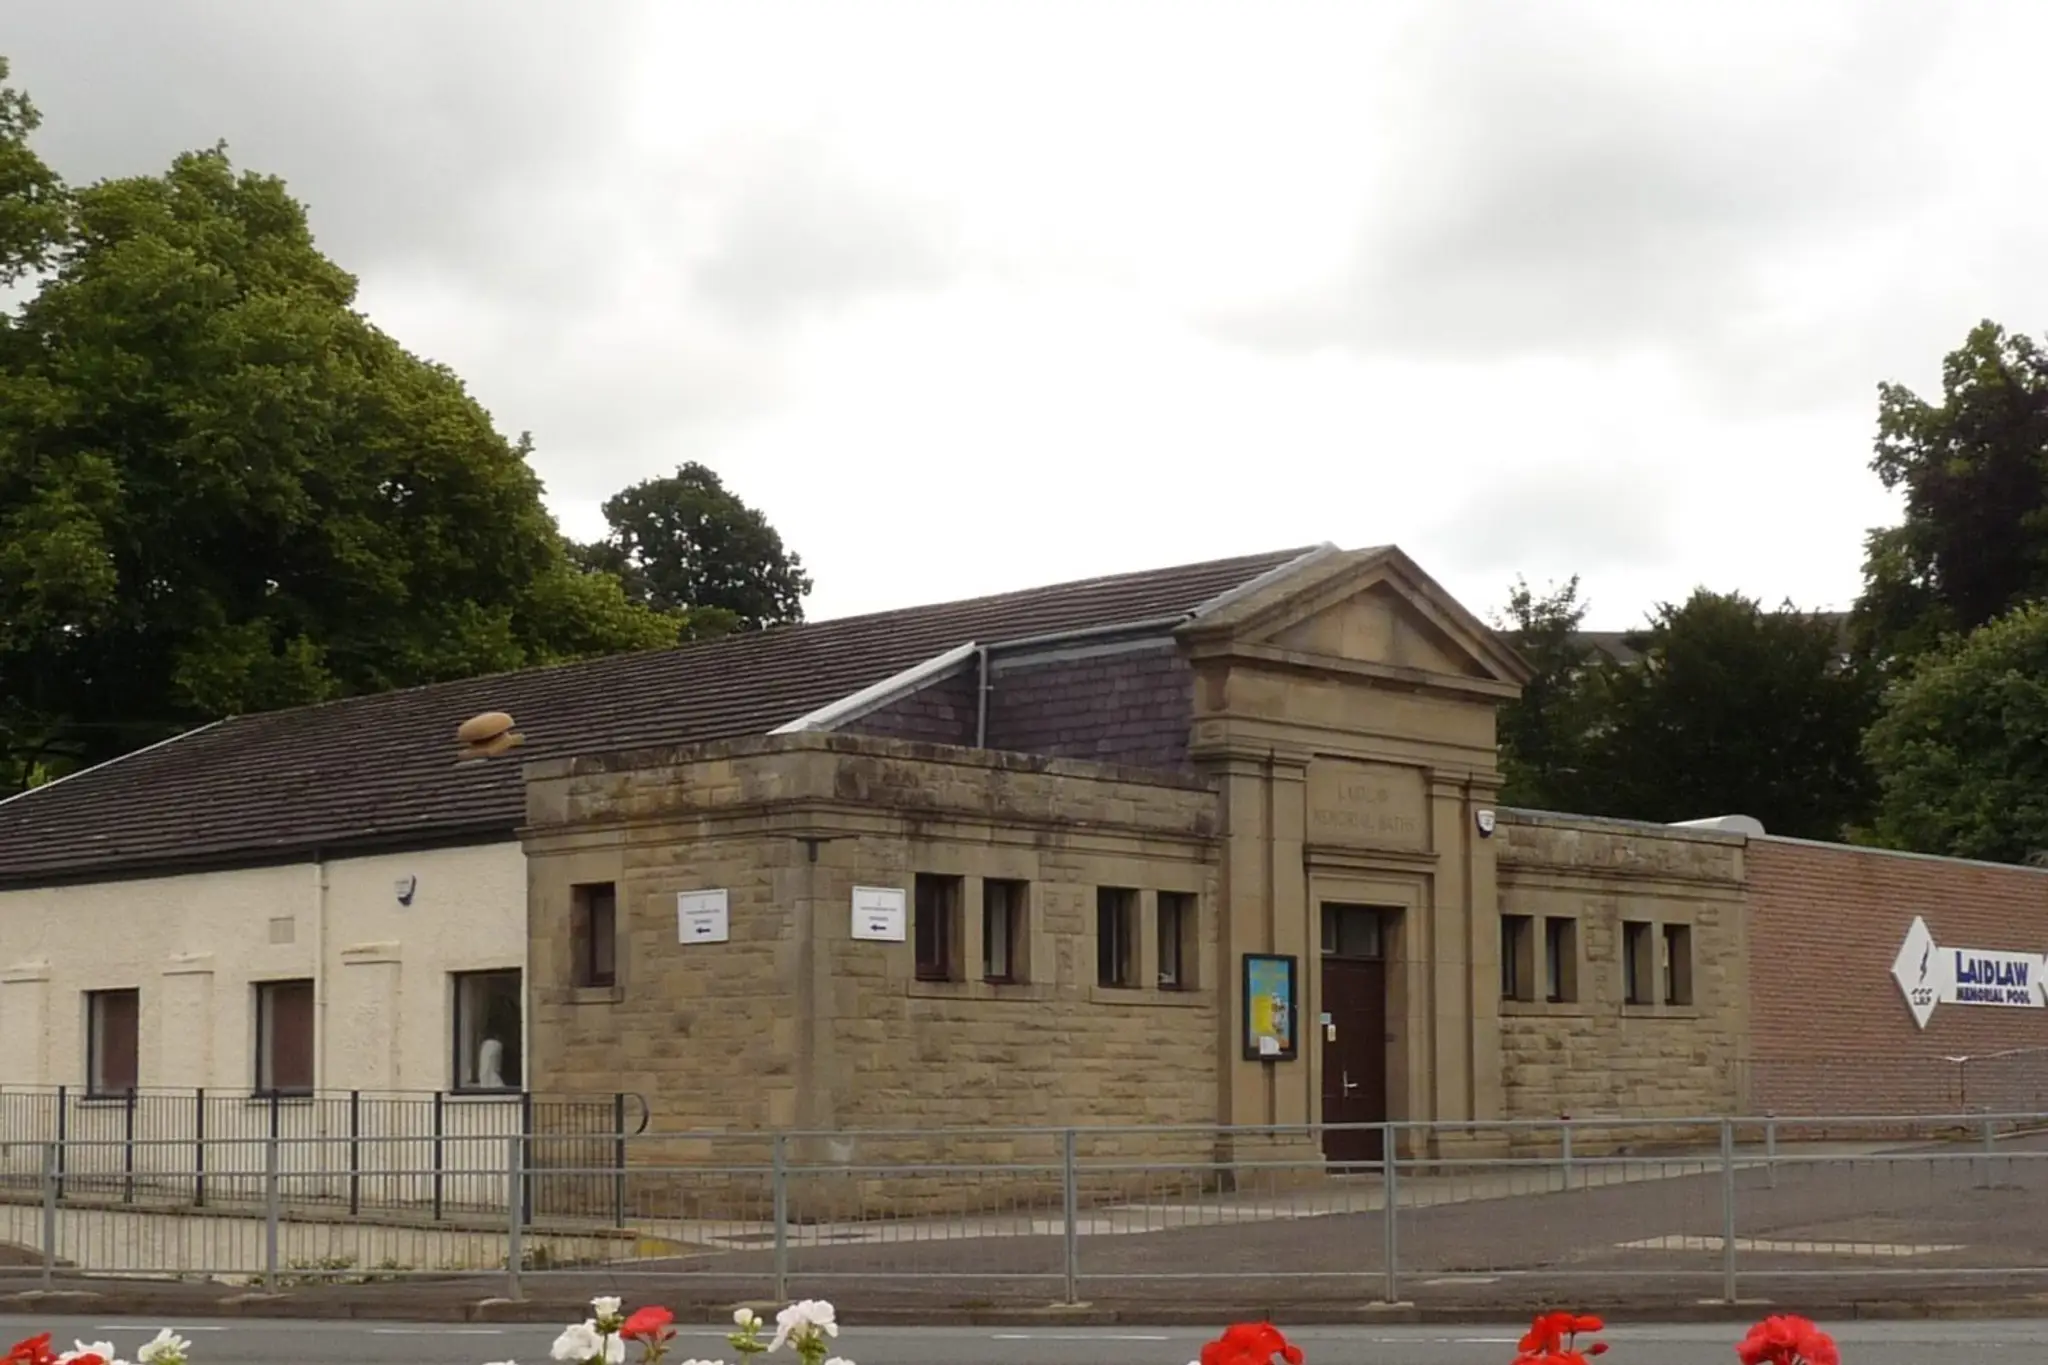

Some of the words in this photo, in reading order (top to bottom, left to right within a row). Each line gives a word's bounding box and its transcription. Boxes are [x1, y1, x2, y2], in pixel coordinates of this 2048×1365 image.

[1956, 951, 2029, 986] LAIDLAW
[1956, 987, 2004, 1003] MEMORIAL
[2006, 989, 2032, 1004] POOL
